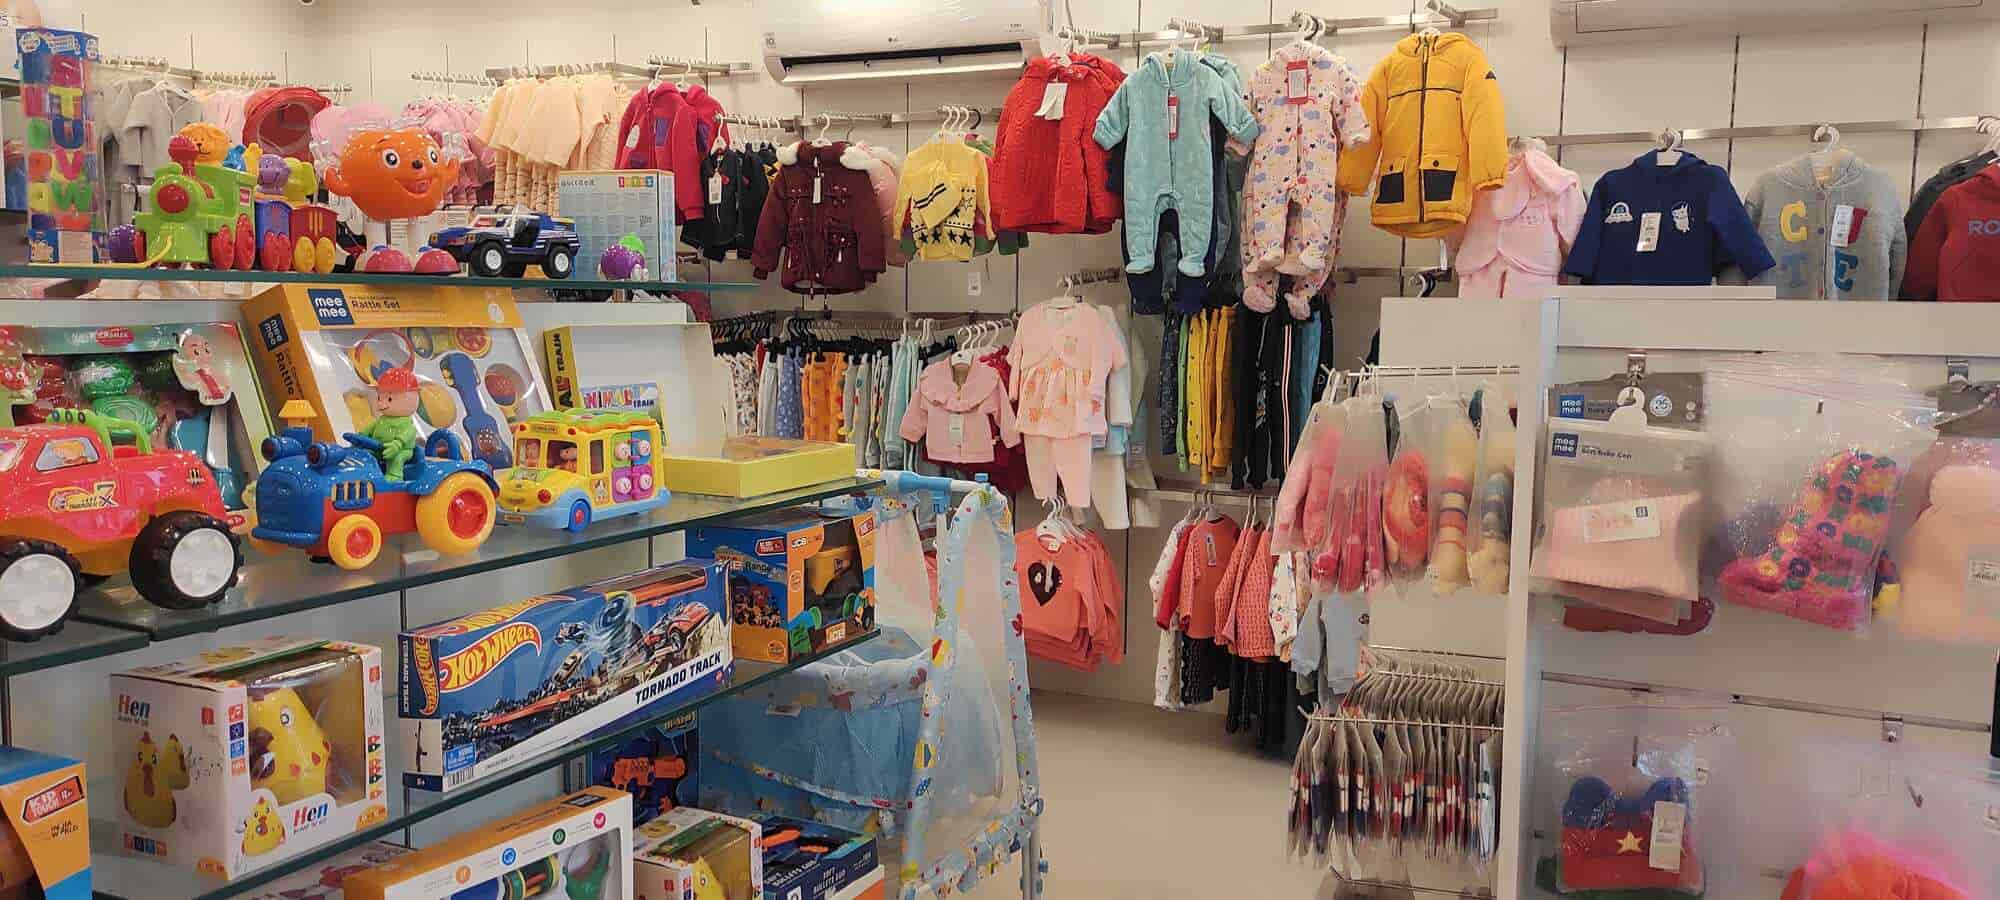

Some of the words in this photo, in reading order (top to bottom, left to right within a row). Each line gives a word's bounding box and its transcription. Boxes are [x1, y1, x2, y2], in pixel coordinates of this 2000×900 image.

[1779, 199, 1808, 243] C
[314, 296, 344, 307] mee
[318, 306, 348, 319] mee
[351, 300, 382, 309] Rattle
[635, 668, 687, 705] TORNADO
[689, 651, 721, 678] TRACK
[118, 693, 151, 720] Hen
[293, 802, 329, 827] Hen
